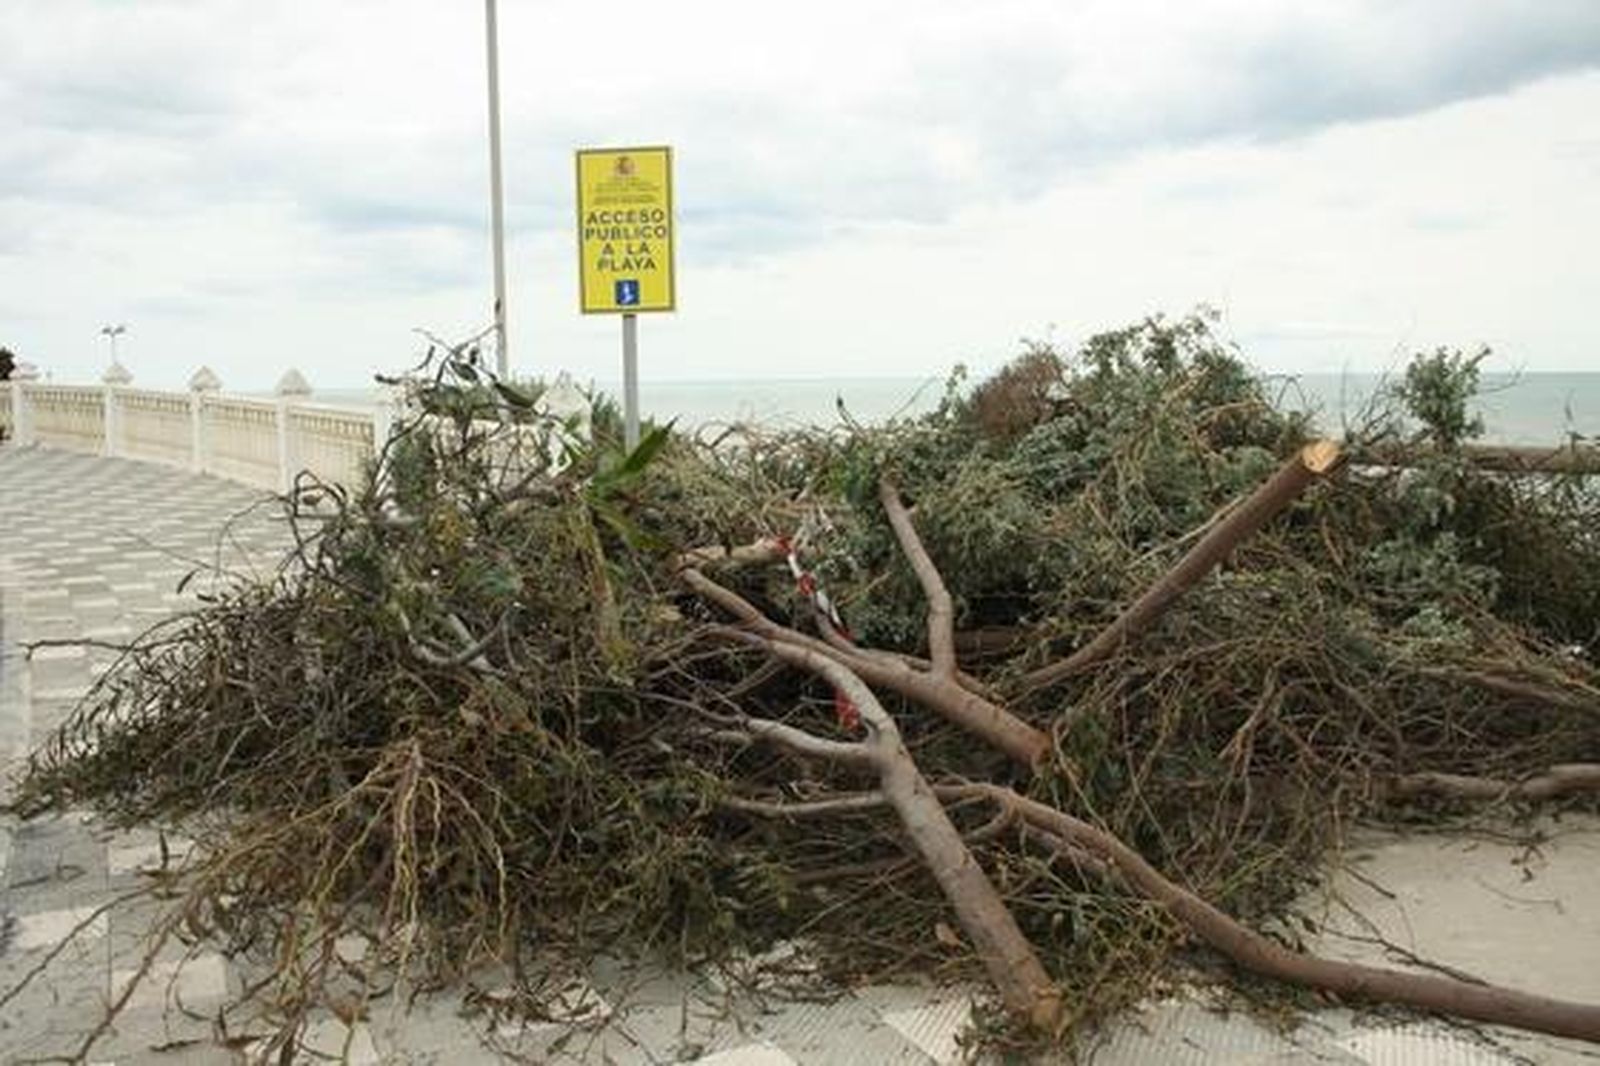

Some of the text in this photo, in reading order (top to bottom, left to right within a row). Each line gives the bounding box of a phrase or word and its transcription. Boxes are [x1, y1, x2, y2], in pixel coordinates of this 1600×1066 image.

[586, 208, 665, 224] ACCESO
[602, 241, 651, 255] A LA
[597, 257, 657, 273] PLAYA
